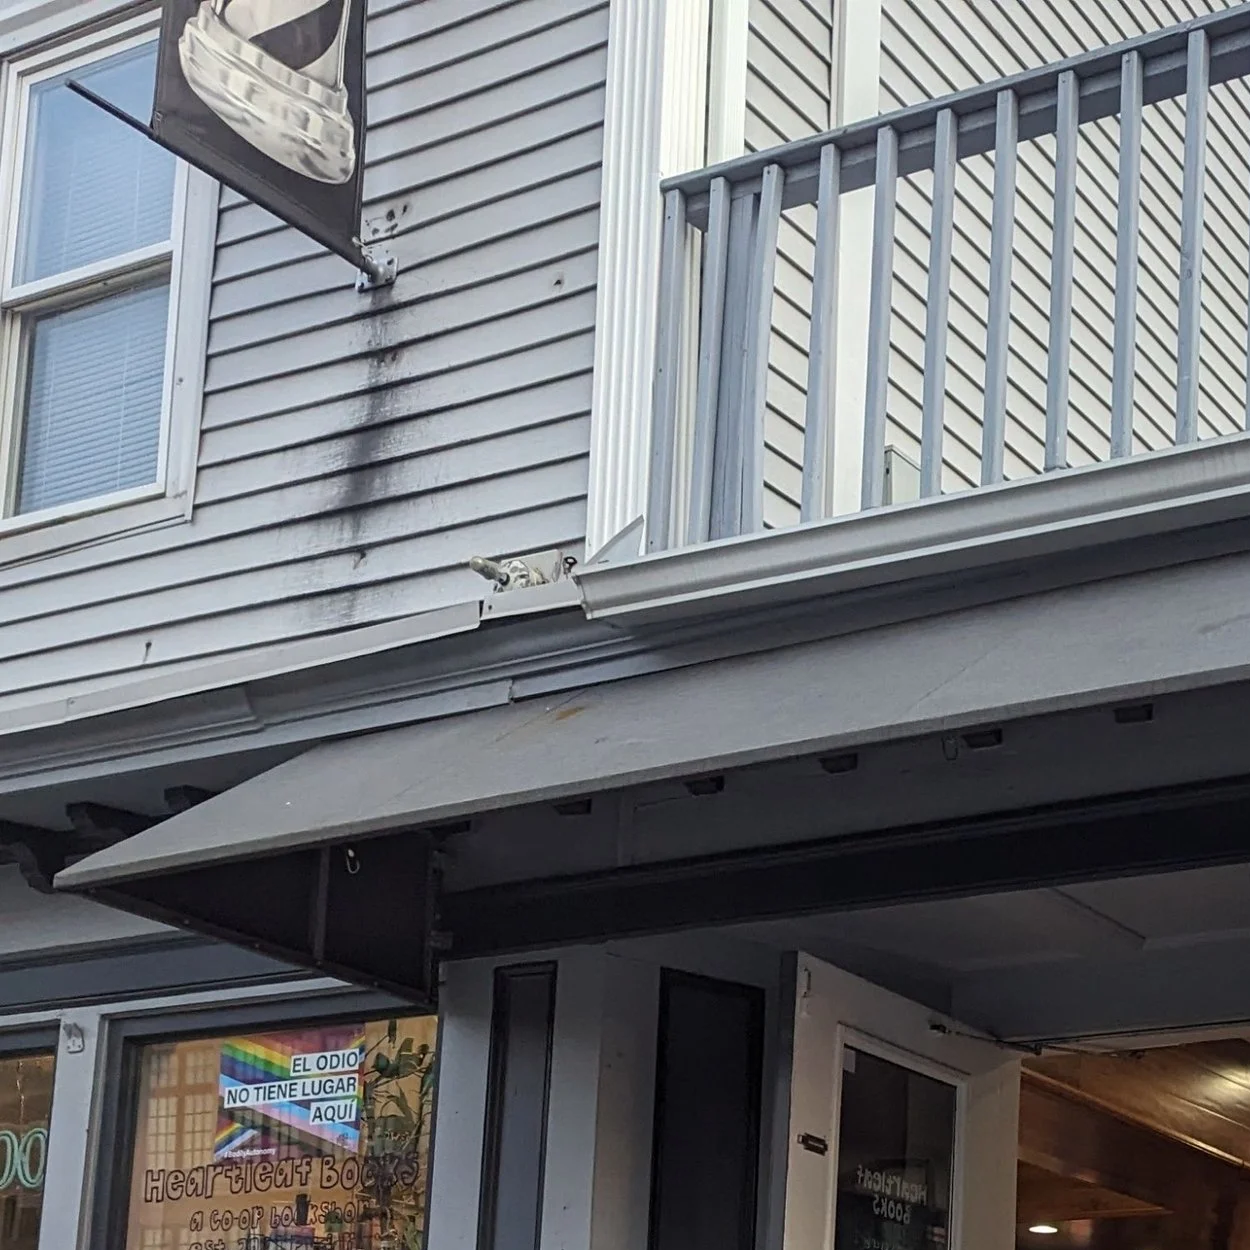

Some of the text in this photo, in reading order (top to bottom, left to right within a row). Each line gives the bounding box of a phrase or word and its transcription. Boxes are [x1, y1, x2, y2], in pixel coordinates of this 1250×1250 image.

[291, 1051, 359, 1073] EL ODIO
[226, 1076, 357, 1105] NO TIENE LUGAR
[311, 1100, 356, 1123] AQUÍ
